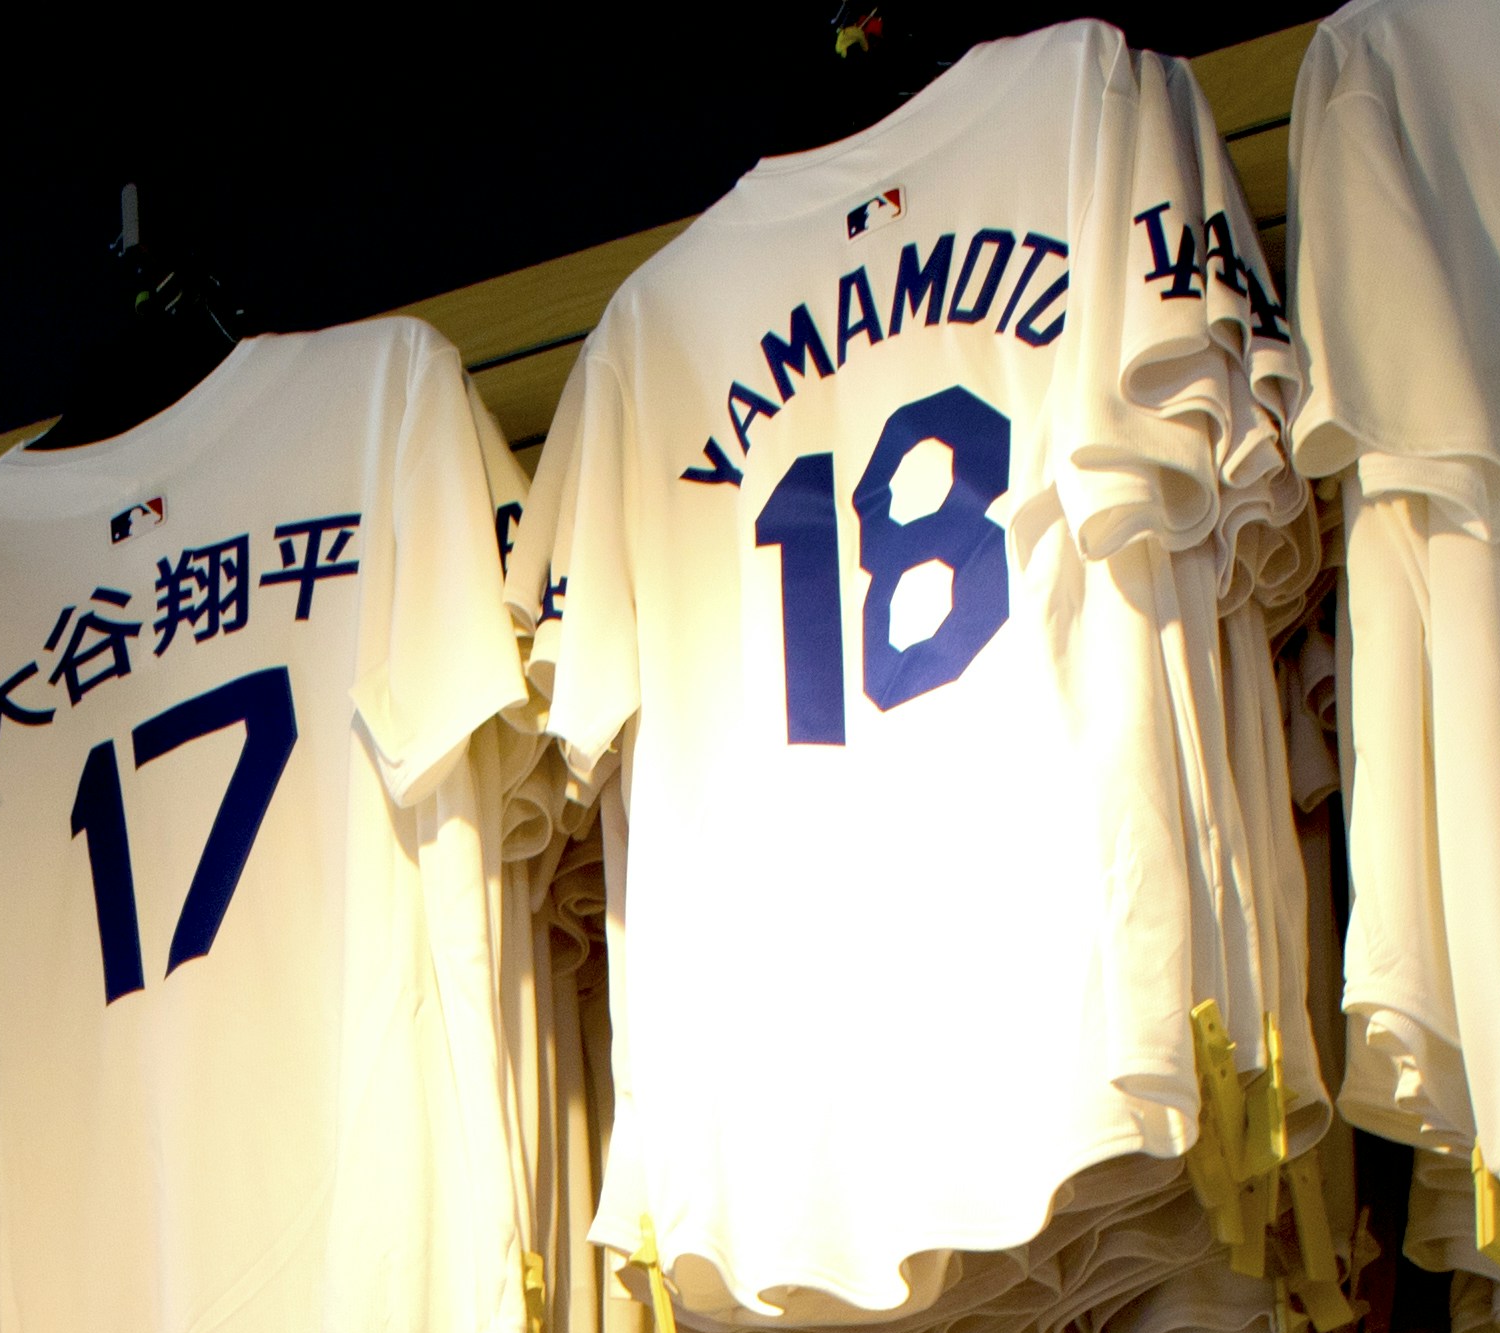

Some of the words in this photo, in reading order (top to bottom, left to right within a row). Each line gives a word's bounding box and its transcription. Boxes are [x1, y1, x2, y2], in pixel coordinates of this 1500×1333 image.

[680, 228, 1069, 490] YAMAMOTO
[755, 385, 1011, 746] 18
[70, 666, 298, 1007] 17
